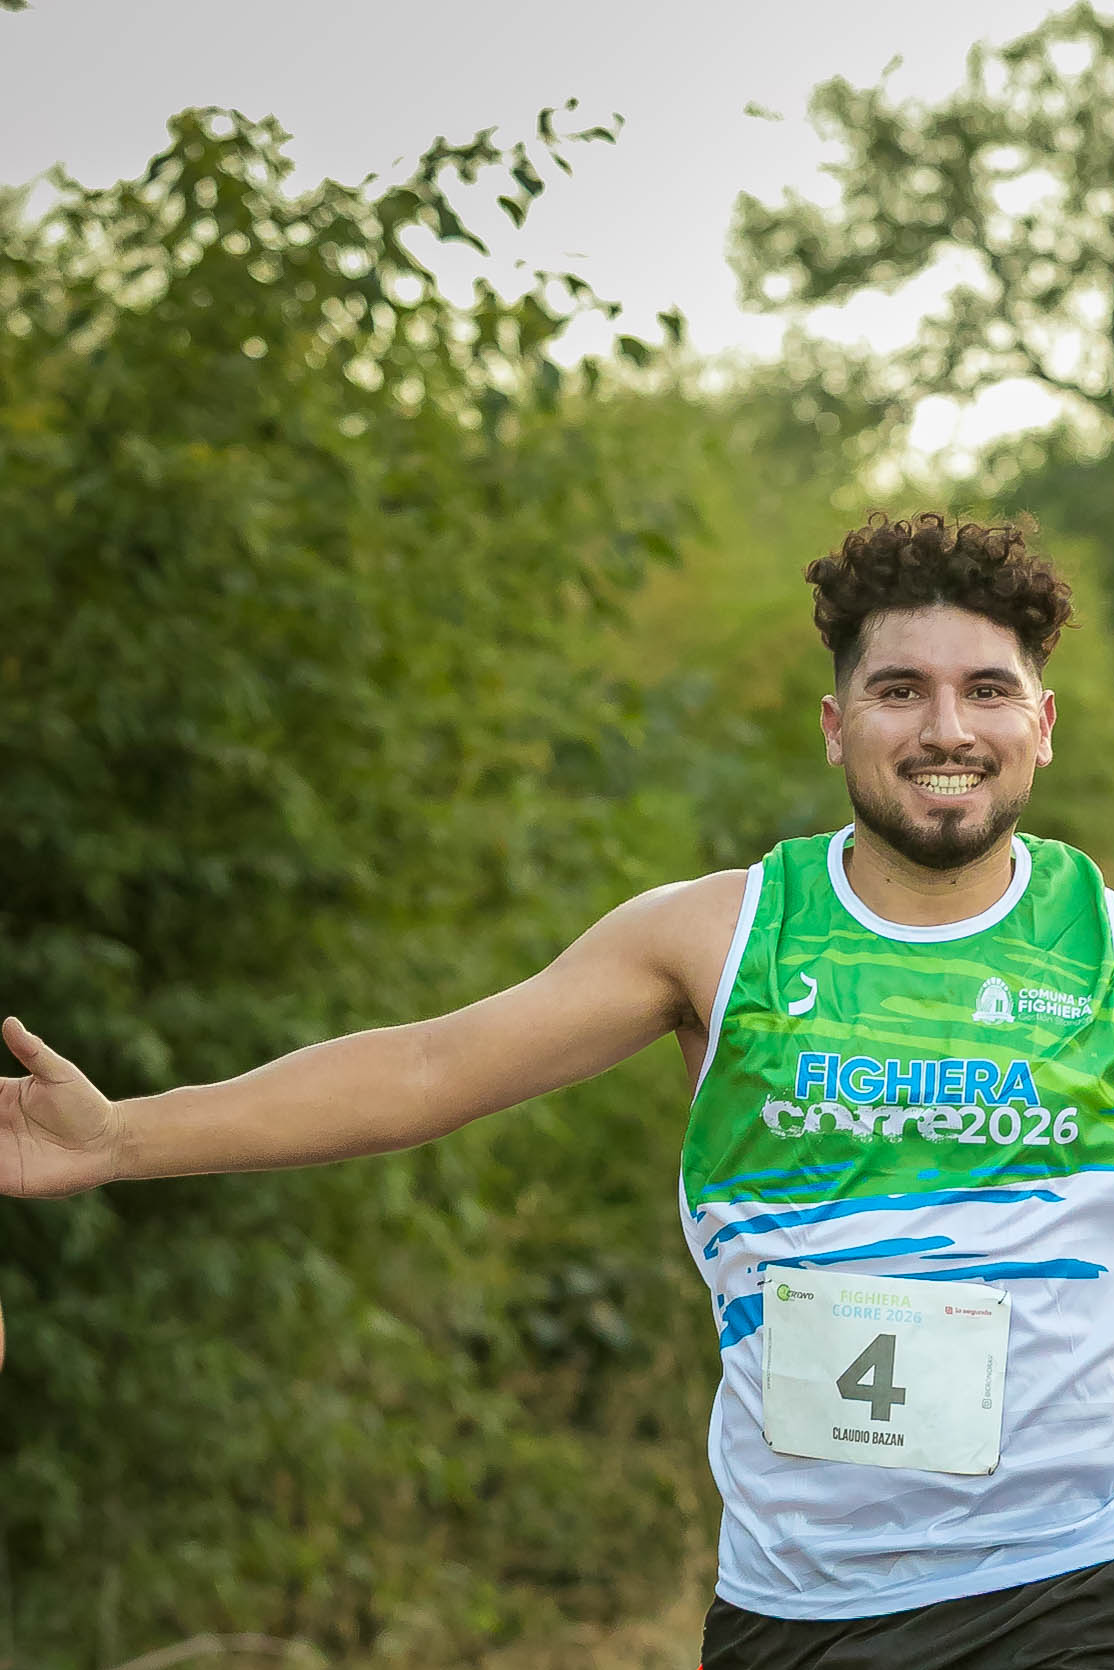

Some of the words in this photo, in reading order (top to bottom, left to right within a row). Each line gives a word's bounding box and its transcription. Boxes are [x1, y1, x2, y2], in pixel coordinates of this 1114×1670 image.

[1019, 988, 1075, 1005] COMUNA
[1018, 999, 1092, 1019] FIGHIERA
[795, 1052, 1040, 1106] FIGHIERA
[840, 1289, 913, 1308] FIGHIERA
[832, 1304, 881, 1321] CORRE
[887, 1309, 922, 1324] 2026
[836, 1333, 906, 1422] 4
[832, 1426, 870, 1443] CLAUDIO
[872, 1432, 905, 1447] BAZAN
